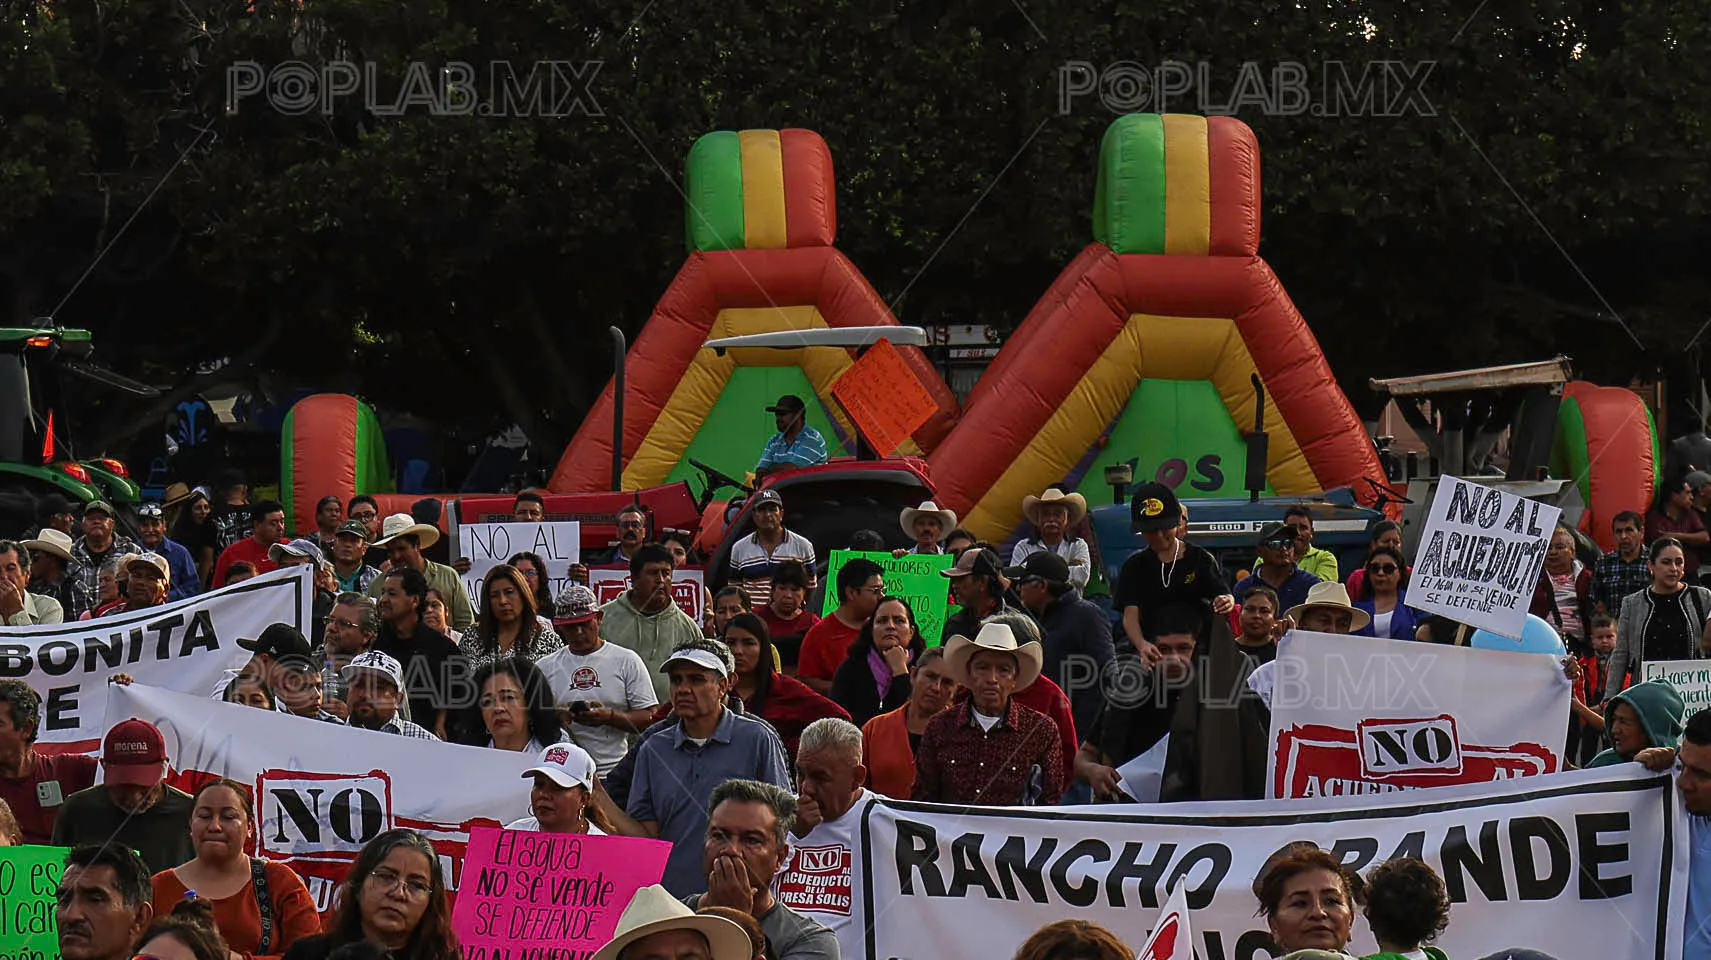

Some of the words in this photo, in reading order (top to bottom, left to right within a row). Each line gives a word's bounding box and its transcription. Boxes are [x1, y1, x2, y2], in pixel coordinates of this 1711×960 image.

[1446, 482, 1501, 529] NO
[1504, 498, 1542, 537] AL
[470, 525, 511, 560] NO
[532, 525, 568, 560] AL
[1425, 593, 1440, 604] SE
[1446, 595, 1496, 614] DEFIENDE
[1456, 582, 1468, 592] NO
[1470, 586, 1484, 595] SE
[1486, 588, 1519, 609] VENDE
[114, 742, 148, 751] morena
[1368, 727, 1452, 767] NO
[270, 788, 383, 844] NO
[494, 831, 517, 865] El
[518, 837, 582, 876] agua
[804, 851, 838, 868] NO
[894, 818, 1233, 911] RANCHO
[475, 867, 508, 897] NO
[783, 873, 851, 887] ACUEDUCTO
[805, 886, 815, 894] DE
[816, 886, 825, 894] LA
[815, 893, 850, 907] SOLIS
[475, 902, 502, 936] SE
[509, 906, 601, 940] DEFIENDE
